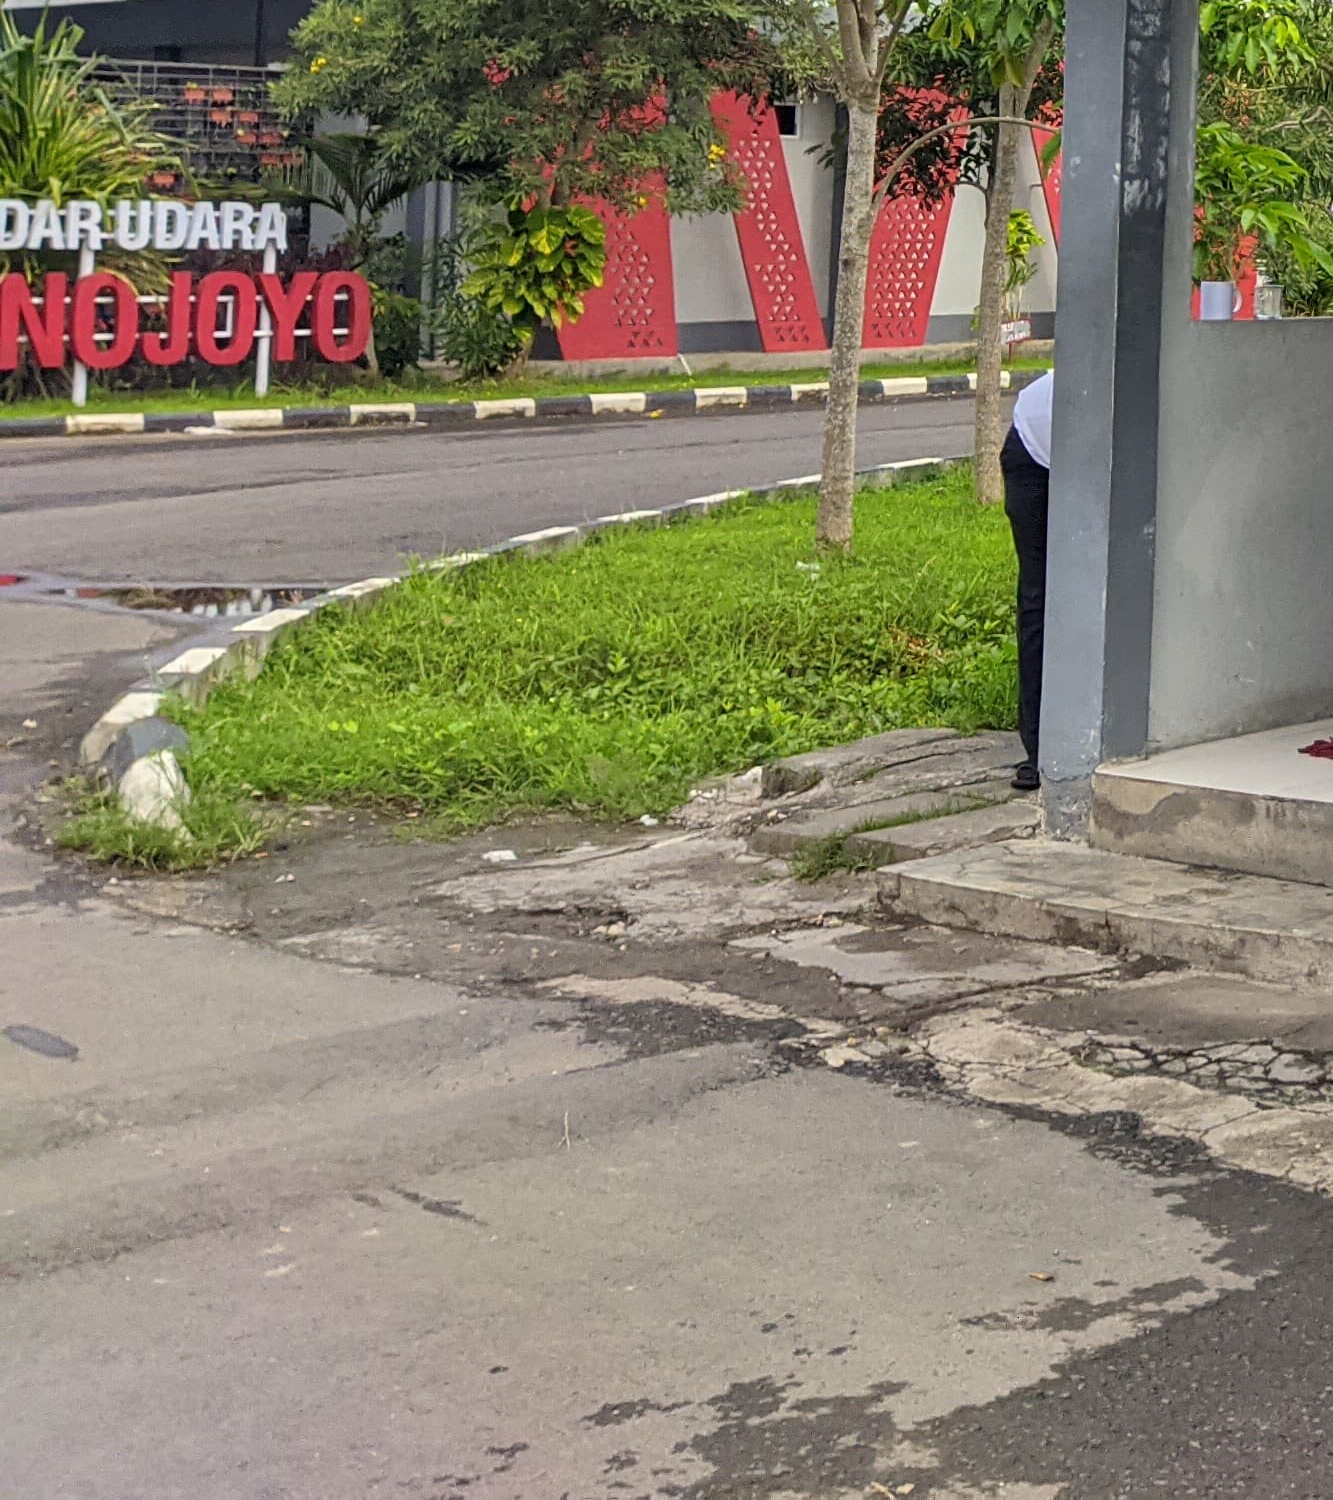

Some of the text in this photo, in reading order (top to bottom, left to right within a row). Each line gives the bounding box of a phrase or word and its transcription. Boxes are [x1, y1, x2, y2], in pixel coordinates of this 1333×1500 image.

[0, 198, 287, 251] DAR UDARA
[0, 270, 372, 371] NOJOYO
